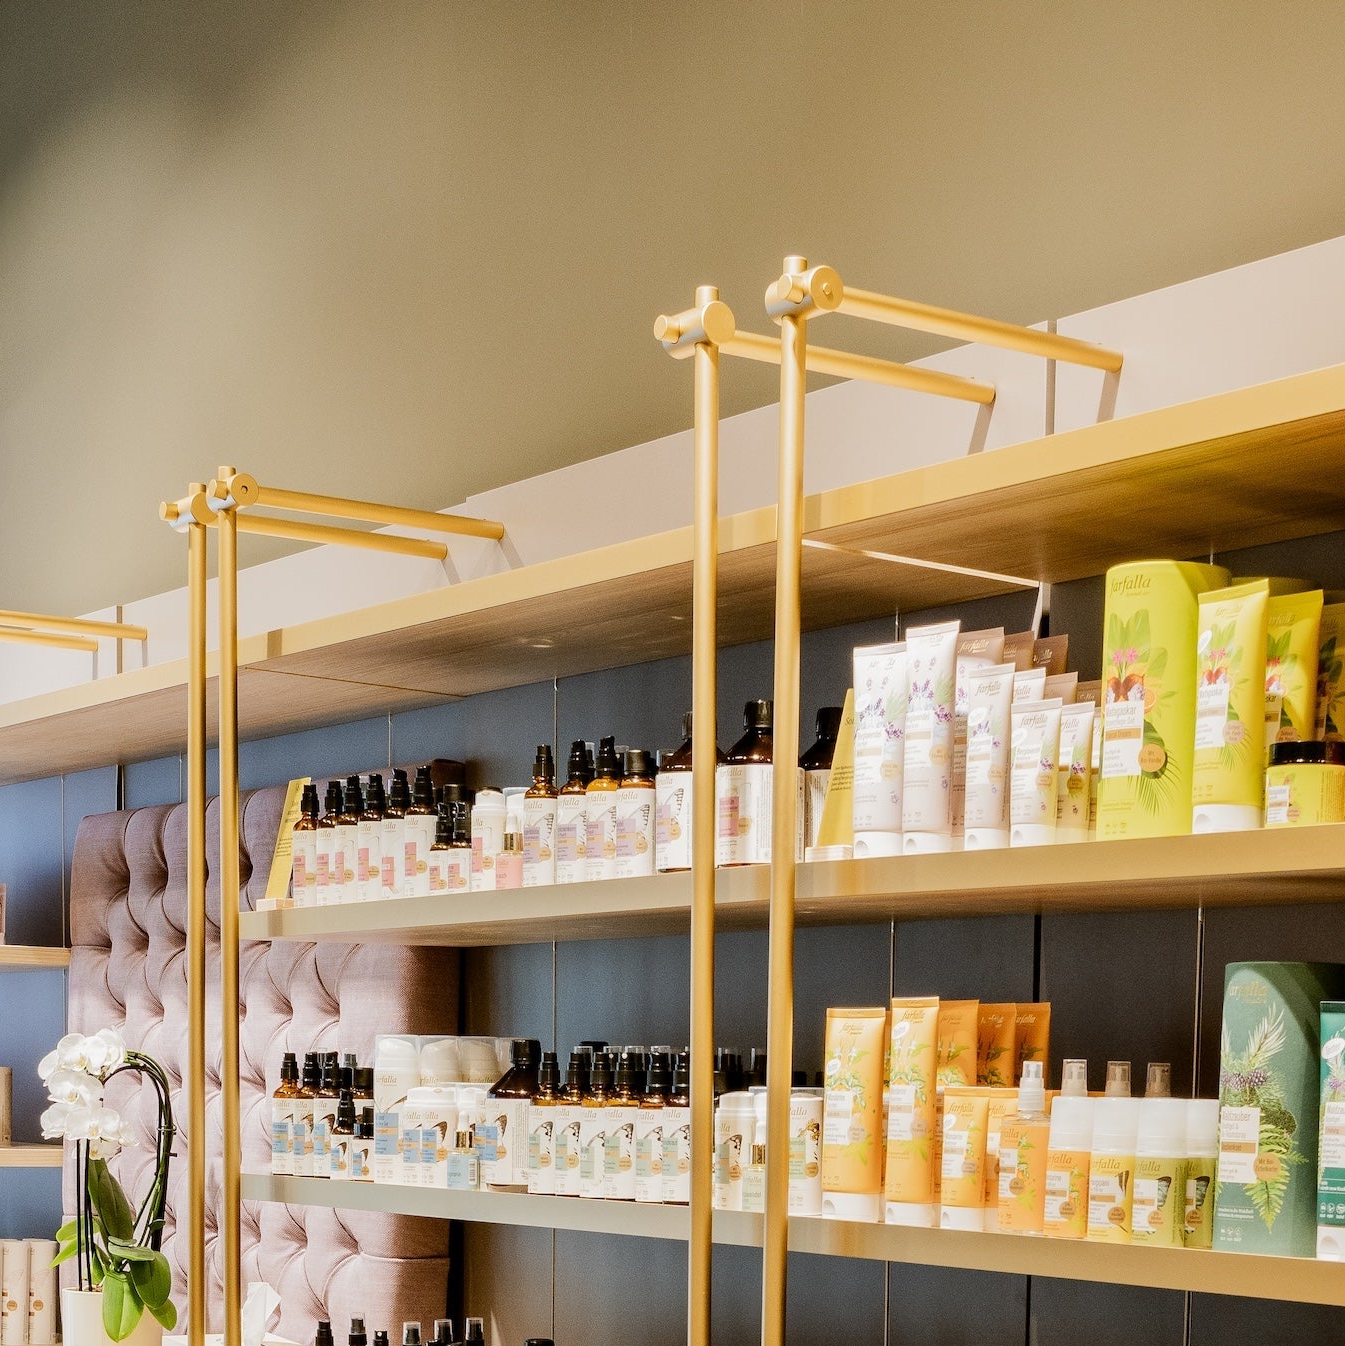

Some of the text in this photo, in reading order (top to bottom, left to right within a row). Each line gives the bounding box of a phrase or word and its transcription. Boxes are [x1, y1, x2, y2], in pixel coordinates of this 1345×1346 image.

[1111, 573, 1151, 595] farfalla
[959, 639, 989, 654] farfalla
[976, 681, 1002, 697] farfalla
[1020, 714, 1048, 728] farfalla
[902, 1010, 926, 1022] farfalla
[1016, 1013, 1037, 1026] arfalla
[949, 1102, 975, 1116] farfalla
[1052, 1152, 1073, 1165] falla
